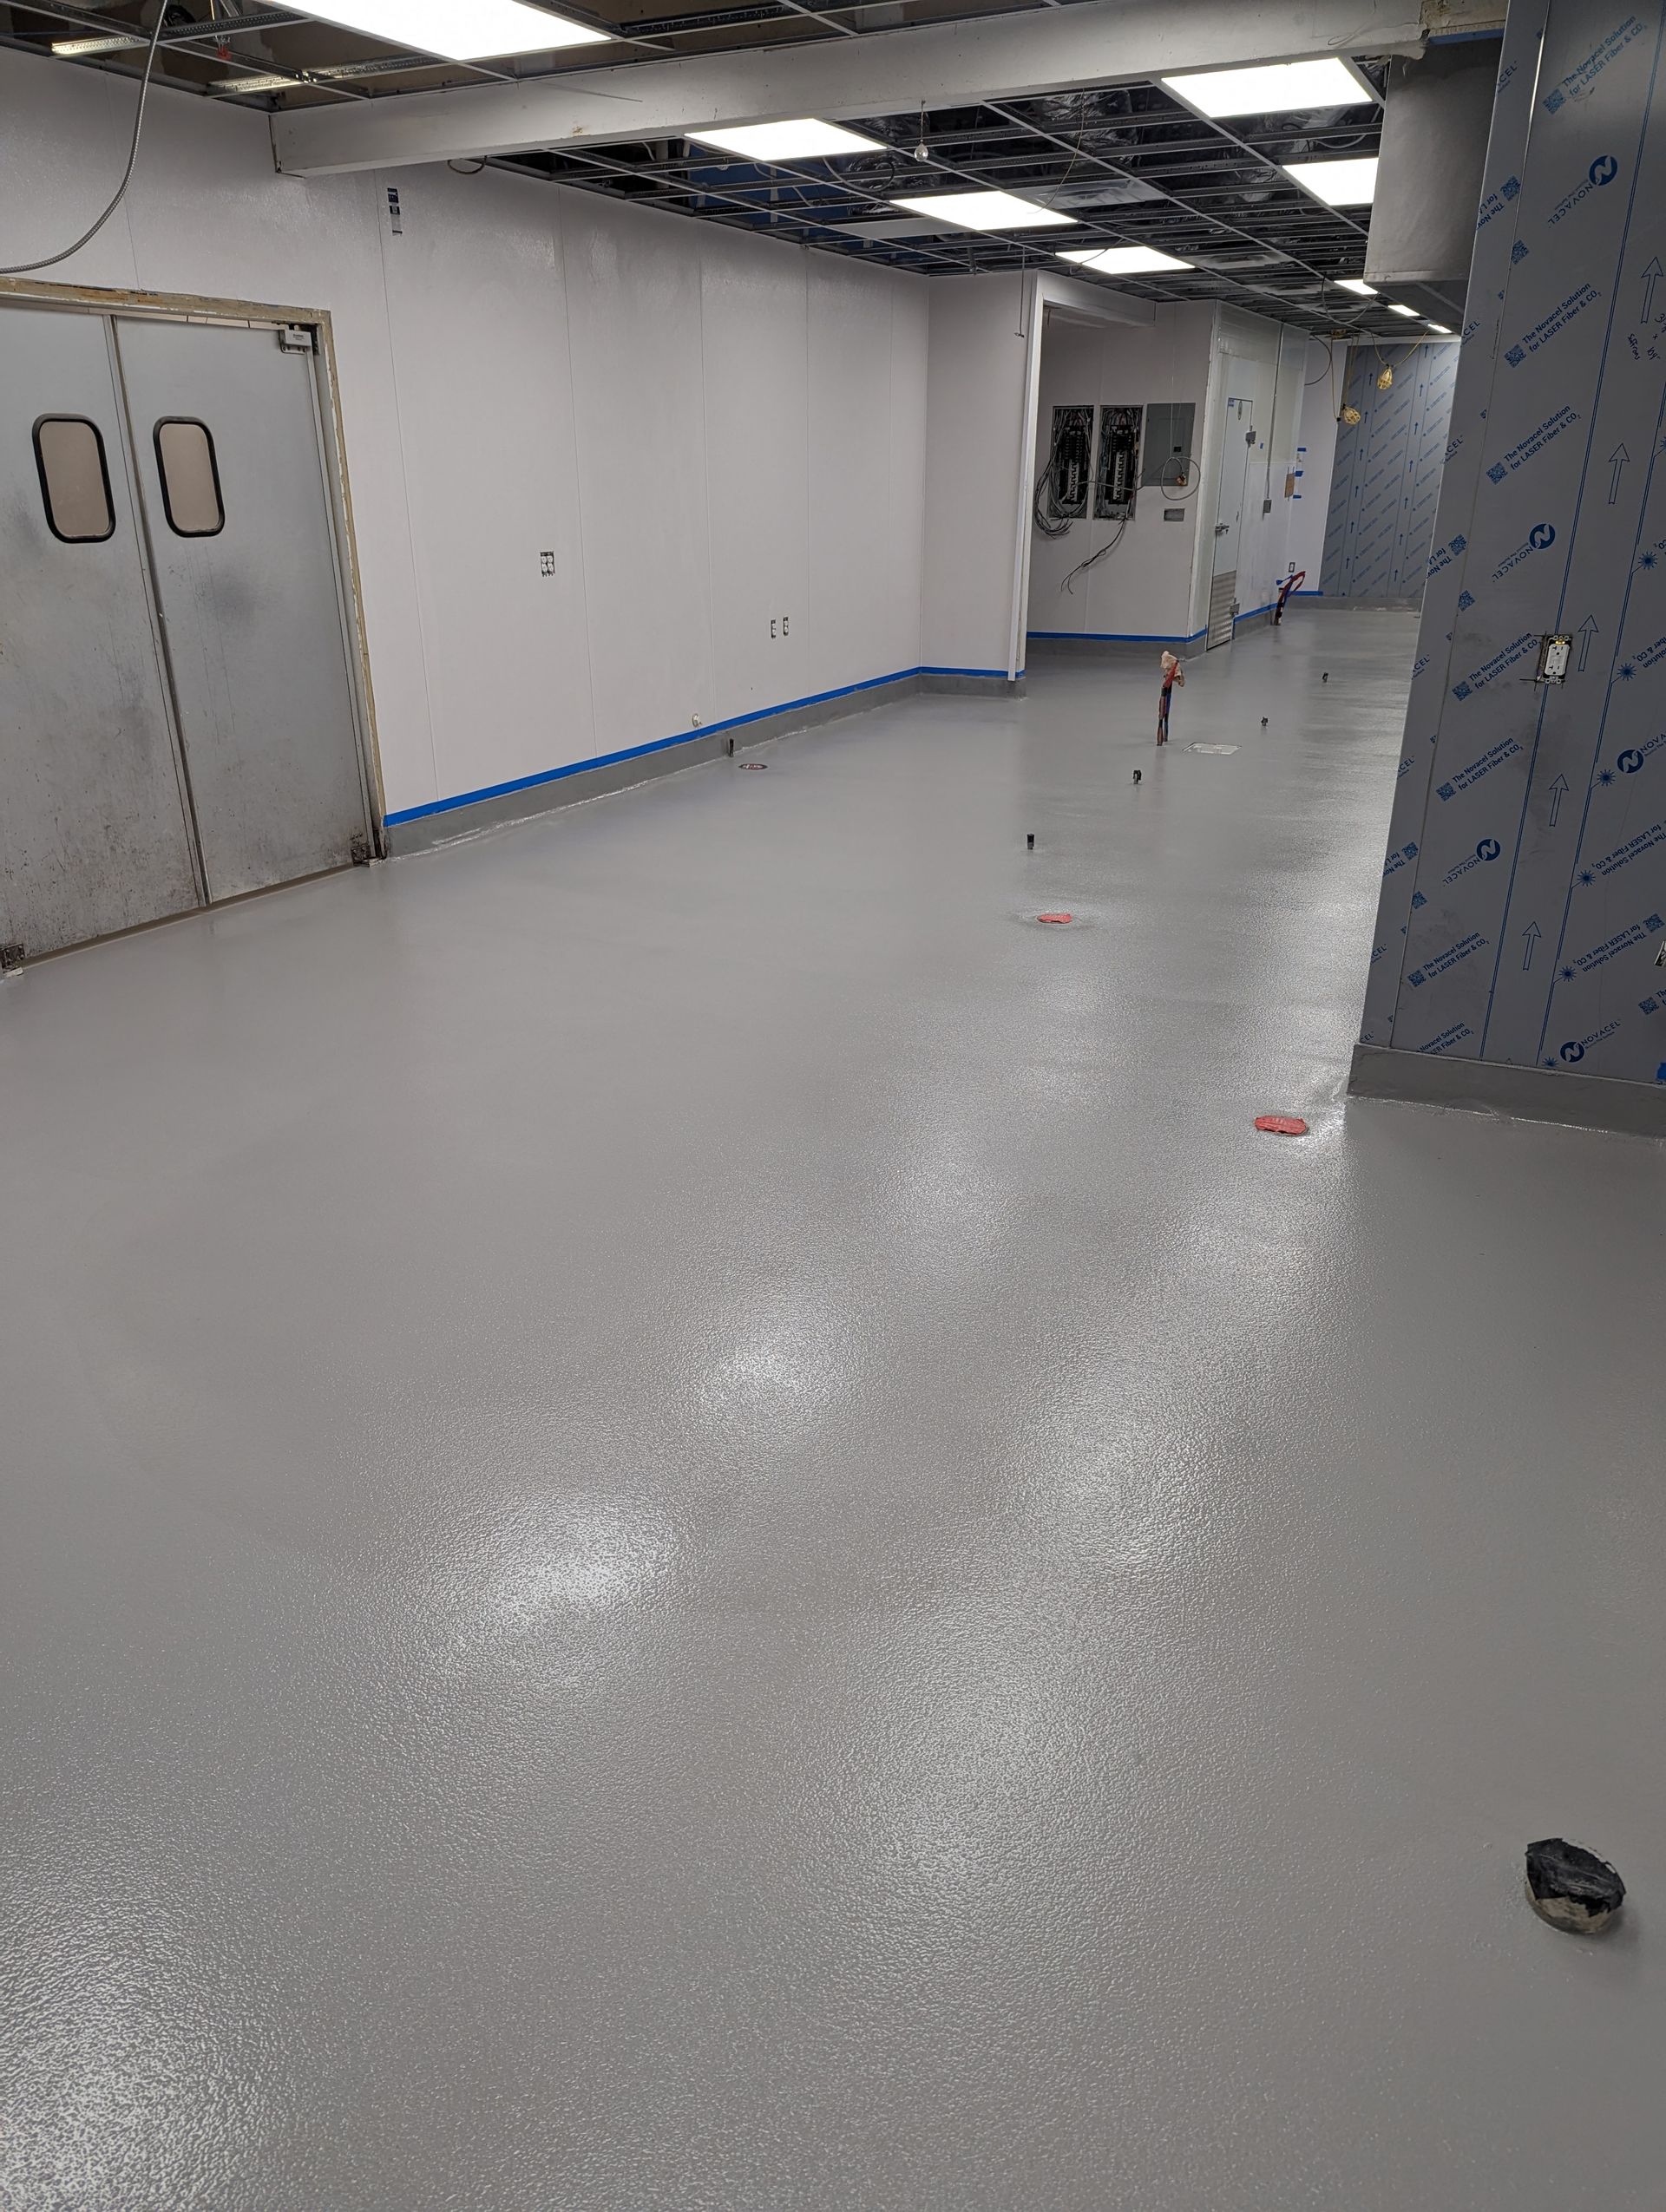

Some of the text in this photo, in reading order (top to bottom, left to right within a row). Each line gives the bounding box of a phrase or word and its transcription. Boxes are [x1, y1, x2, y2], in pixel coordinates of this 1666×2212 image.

[1562, 16, 1636, 87] The Novacel Solution
[1491, 202, 1505, 215] The
[1523, 283, 1591, 344] The Novacel Solution
[1529, 342, 1539, 352] for
[1539, 321, 1562, 344] LASER
[1562, 306, 1579, 323] Fiber
[1504, 406, 1571, 461] The Novacel Solution
[1511, 460, 1520, 470] for
[1520, 442, 1543, 461] LASER
[1543, 427, 1560, 442] Fiber
[1440, 556, 1452, 566] The
[1468, 633, 1532, 681] The Novacel Solution
[1475, 680, 1484, 689] for
[1484, 664, 1506, 682] LASER
[1505, 651, 1522, 666] Fiber
[1453, 737, 1513, 782] The Novacel Solution
[1459, 782, 1468, 790] for
[1467, 767, 1488, 783] LASER
[1487, 756, 1504, 769] Fiber
[1628, 831, 1650, 848] LASER
[1650, 824, 1661, 833] for
[1612, 845, 1630, 858] Fiber
[1628, 840, 1654, 860] Novacel
[1602, 857, 1630, 876] Solution
[1433, 947, 1456, 964] Novacel
[1456, 932, 1480, 949] Solution
[1593, 944, 1609, 955] Fiber
[1608, 930, 1631, 946] LASER
[1437, 958, 1457, 972] LASER
[1457, 949, 1472, 960] Fiber
[1583, 932, 1647, 972] The Novacel Solution
[1441, 1022, 1465, 1039] Solution
[1441, 1037, 1456, 1050] Fiber
